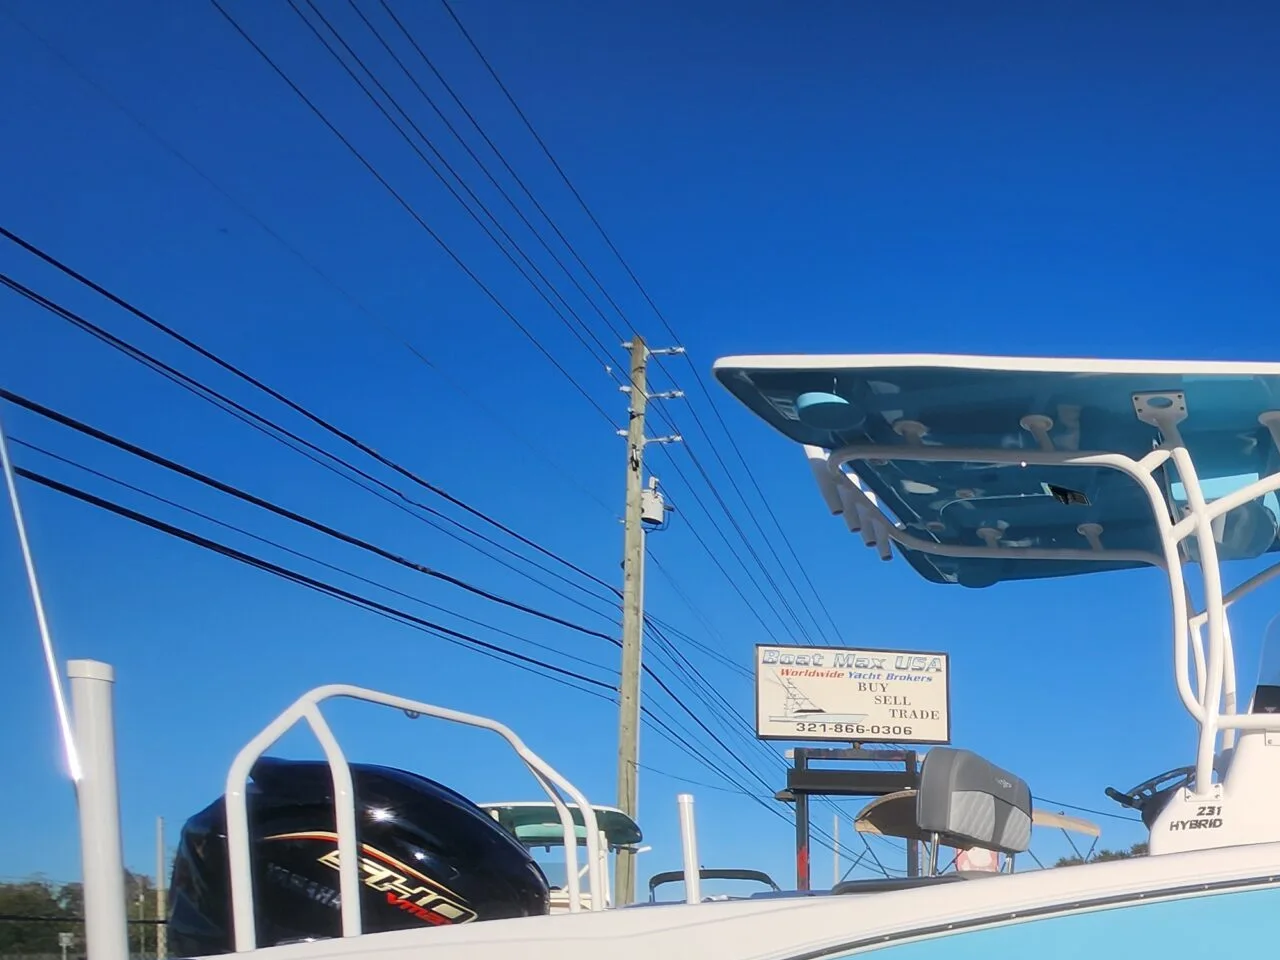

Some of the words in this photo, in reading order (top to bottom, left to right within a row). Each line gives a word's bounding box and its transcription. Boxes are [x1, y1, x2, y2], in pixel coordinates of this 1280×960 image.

[762, 650, 824, 666] Boat
[833, 653, 886, 670] Max
[895, 656, 942, 672] USA
[780, 668, 844, 679] Worldwide
[849, 671, 881, 681] Yacht
[886, 672, 933, 682] Brokers
[858, 682, 889, 692] BUY
[875, 695, 911, 705] SELL
[889, 709, 940, 720] TRADE
[796, 722, 912, 735] 321-866-0306
[1197, 806, 1222, 816] 231
[1169, 818, 1223, 831] HYBRID
